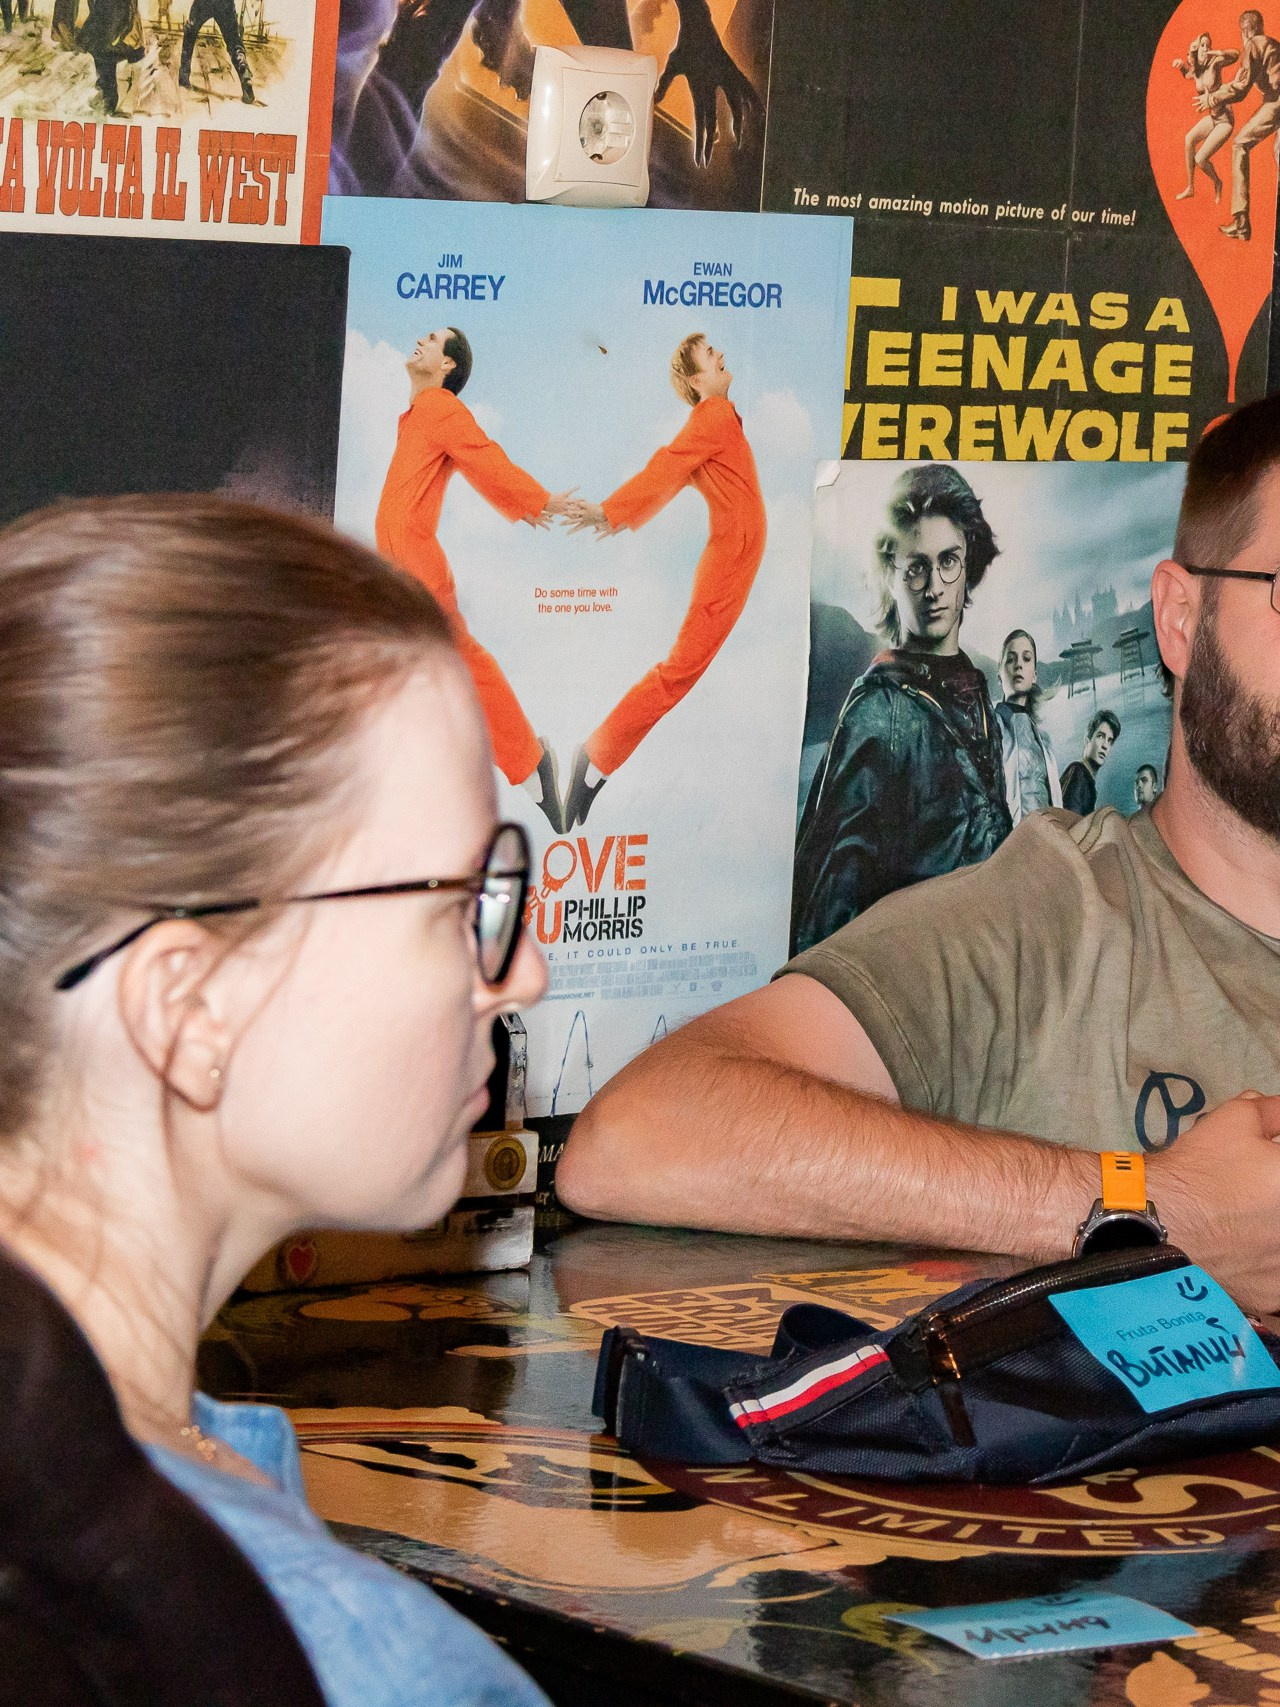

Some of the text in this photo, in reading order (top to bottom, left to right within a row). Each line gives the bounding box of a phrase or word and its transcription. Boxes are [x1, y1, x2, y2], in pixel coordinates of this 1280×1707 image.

[36, 119, 144, 217] VOLTA
[151, 126, 187, 221] IL
[198, 129, 297, 226] WEST
[794, 187, 1136, 226] The most amazing motion picture of our time!
[437, 253, 463, 269] JIM
[693, 261, 732, 276] EWAN
[396, 272, 506, 301] CARREY
[643, 279, 782, 308] McGREGOR
[942, 286, 1191, 333] I WAS A
[534, 586, 618, 598] Do some time with
[538, 602, 612, 615] the one you love.
[542, 834, 649, 896] OVE
[564, 896, 646, 921] PHILLIP
[563, 918, 643, 943] MORRIS
[567, 951, 579, 959] IT
[587, 947, 632, 958] COULD
[640, 945, 673, 954] ONLY
[681, 942, 697, 951] BE
[1116, 1311, 1208, 1342] Fruta Bonita
[752, 1492, 1227, 1548] LIMITED
